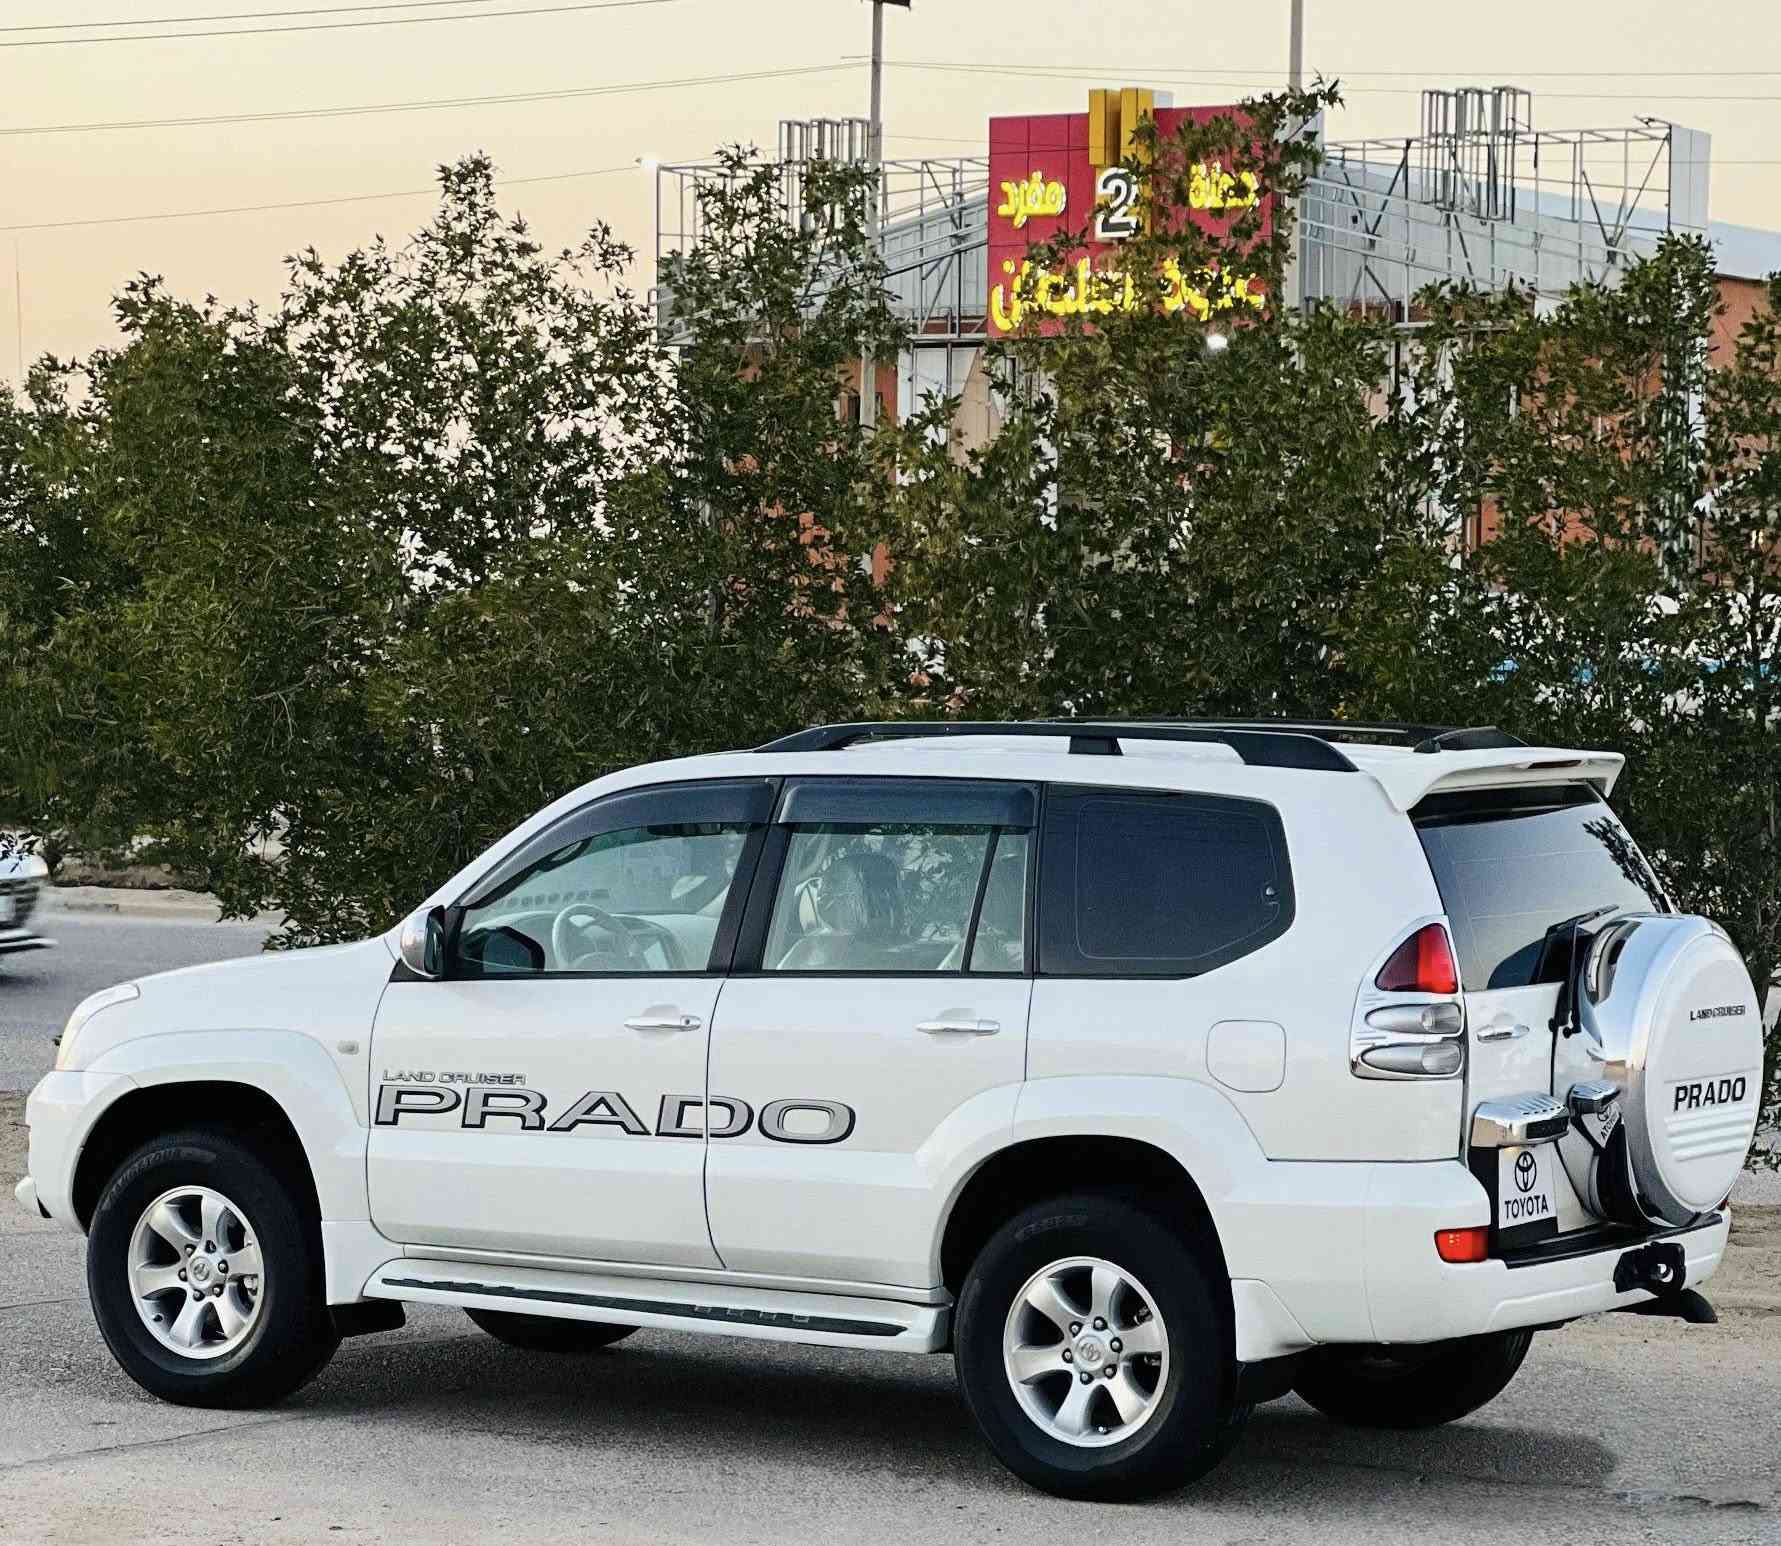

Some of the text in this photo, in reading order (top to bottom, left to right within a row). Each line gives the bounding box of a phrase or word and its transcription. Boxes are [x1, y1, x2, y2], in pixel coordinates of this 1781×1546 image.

[997, 170, 1067, 229] مفرد
[1095, 166, 1138, 238] 2
[383, 1070, 527, 1085] LAND CRUISER
[1674, 1076, 1746, 1112] PRADO
[374, 1083, 856, 1145] PRADO
[1504, 1194, 1549, 1220] TOYOTA
